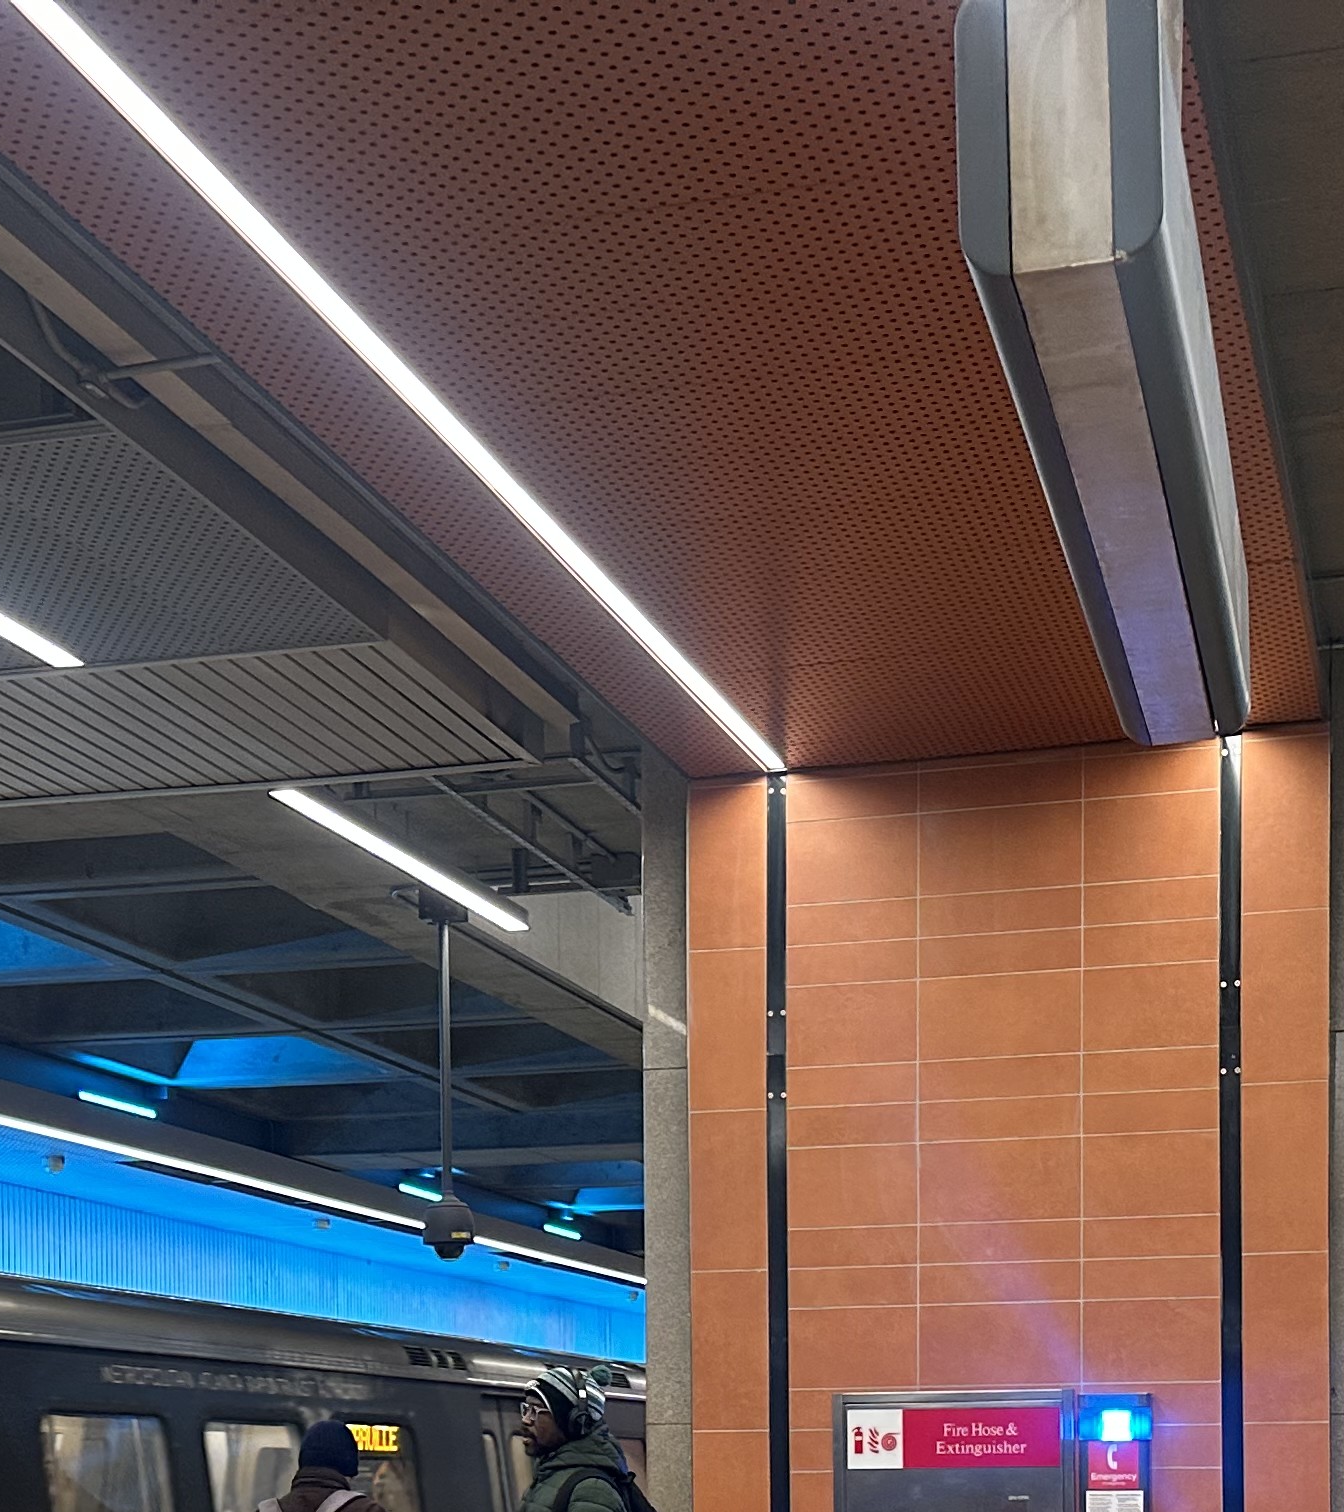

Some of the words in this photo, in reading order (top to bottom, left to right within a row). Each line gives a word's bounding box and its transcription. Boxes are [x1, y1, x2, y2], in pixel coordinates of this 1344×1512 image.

[345, 1423, 400, 1452] RAVILLE
[943, 1423, 969, 1437] Fire
[971, 1422, 1004, 1437] Hose
[1005, 1422, 1018, 1436] &
[936, 1440, 1027, 1457] Extinguisher
[1090, 1472, 1137, 1482] Emergency
